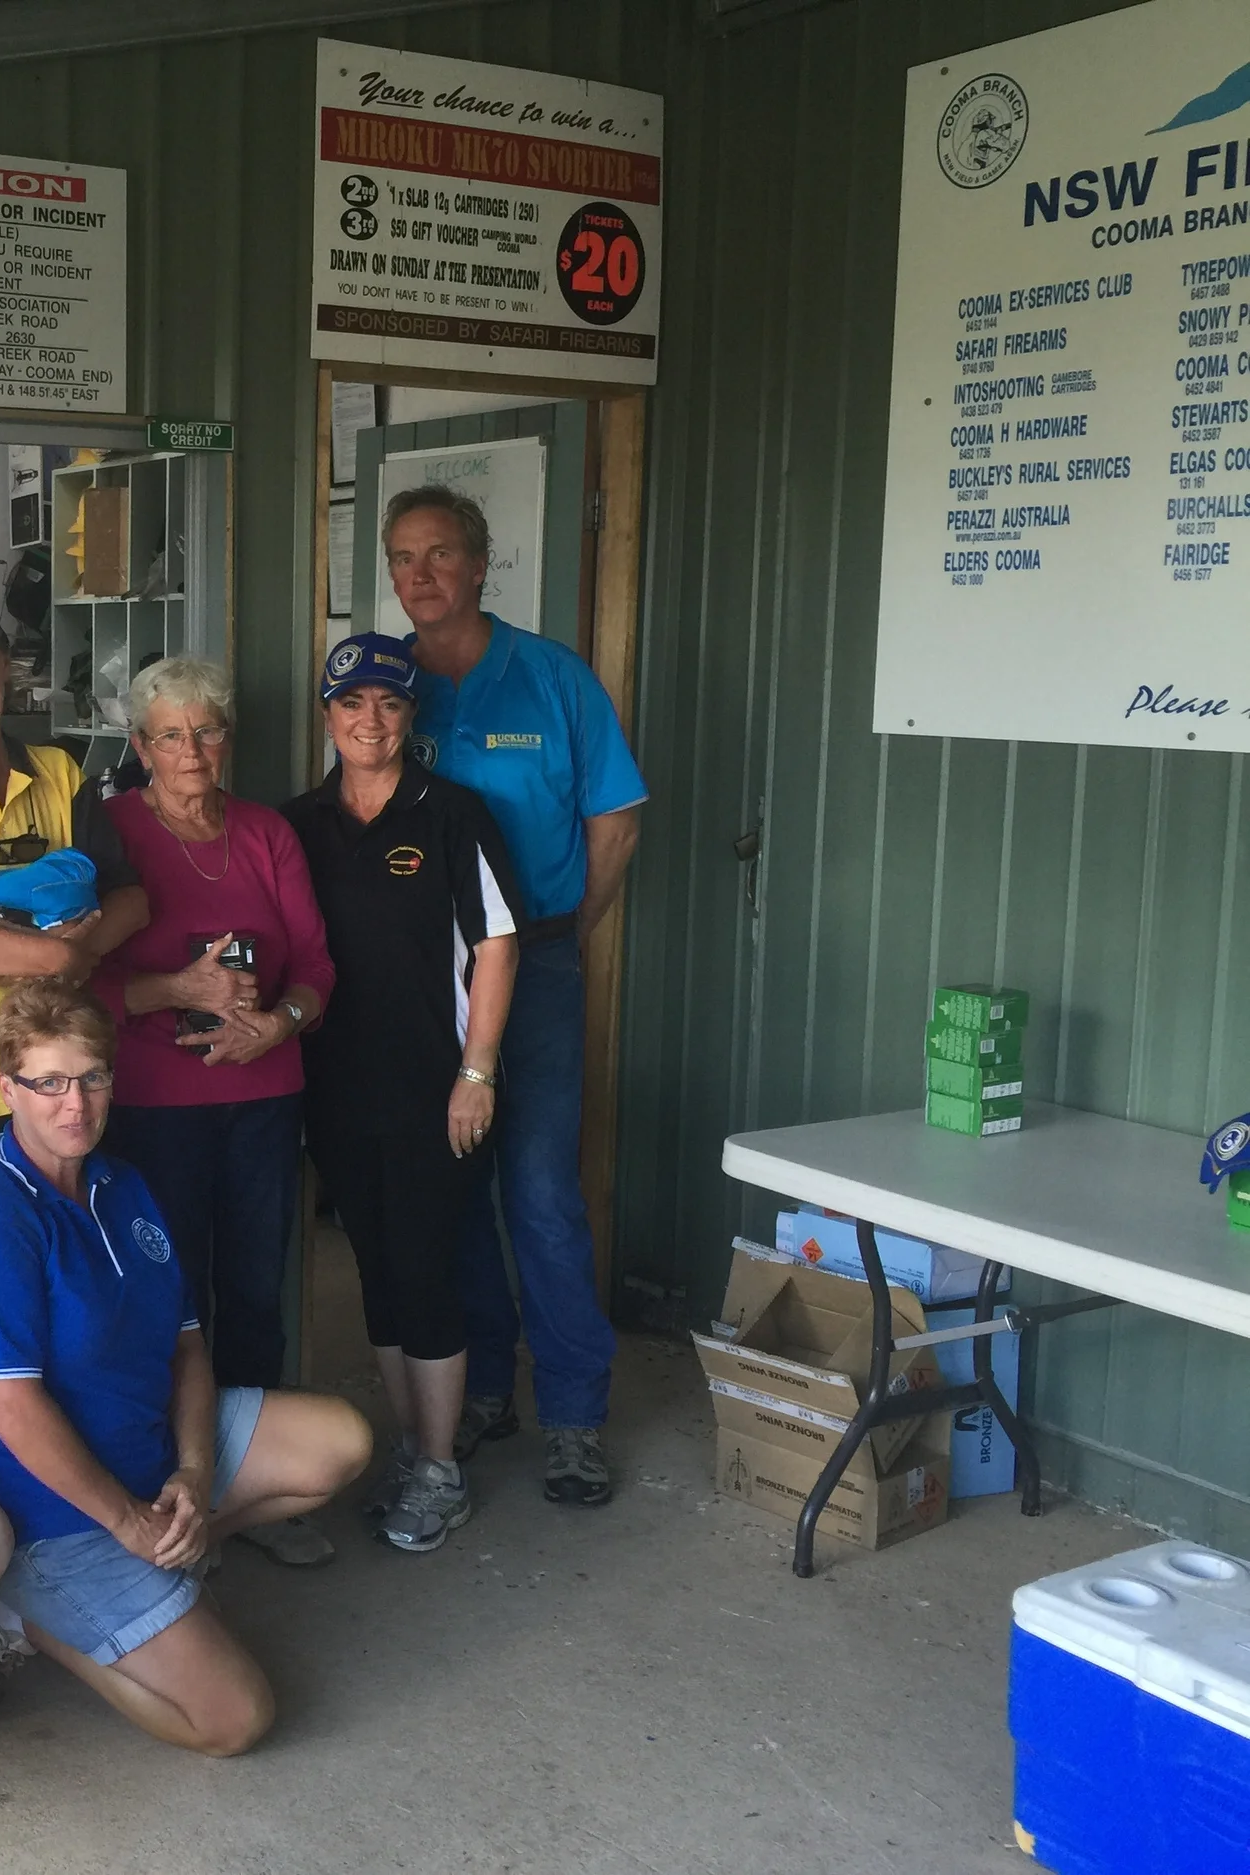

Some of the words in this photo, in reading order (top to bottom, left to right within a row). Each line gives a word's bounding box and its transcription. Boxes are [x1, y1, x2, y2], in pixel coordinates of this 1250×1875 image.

[359, 72, 425, 108] Your
[434, 86, 514, 117] chance
[519, 102, 544, 124] to
[551, 110, 592, 130] win
[942, 87, 978, 138] COOMA
[983, 80, 1024, 121] BRANCH
[336, 116, 443, 168] MIROKU
[452, 131, 520, 178] MK70
[527, 142, 632, 193] SPORTER
[1024, 157, 1158, 227] NSW
[1185, 138, 1250, 197] FI
[346, 177, 376, 202] 2nd
[406, 188, 428, 208] SLAB
[435, 192, 449, 212] 12g
[455, 194, 508, 218] CARTRIDGES
[1, 204, 23, 220] OR
[34, 207, 106, 228] INCIDENT
[584, 214, 624, 229] TICKETS
[1092, 215, 1173, 248] COOMA
[1184, 201, 1250, 233] BRAN
[346, 211, 375, 236] 3rd
[391, 218, 406, 238] $50
[412, 221, 432, 240] GIFT
[437, 223, 479, 247] VOUCHER
[482, 230, 511, 242] CAMPING
[515, 234, 536, 244] WORLD
[15, 244, 72, 262] REQUIRE
[497, 242, 520, 254] COOMA
[4, 261, 22, 274] OR
[31, 264, 92, 280] INCIDENT
[330, 250, 367, 272] DRAWN
[372, 254, 386, 275] ON
[391, 256, 430, 279] SUNDAY
[434, 260, 446, 281] AT
[449, 262, 467, 283] THE
[471, 264, 540, 290] PRESENTATION
[559, 231, 639, 297] $20
[338, 283, 357, 295] YOU
[363, 286, 390, 298] DON'T
[396, 290, 417, 301] HAVE
[424, 292, 435, 303] TO
[440, 294, 450, 305] BE
[456, 296, 490, 308] PRESENT
[495, 300, 506, 310] TO
[587, 300, 614, 312] EACH
[959, 294, 1002, 319] COOMA
[1010, 280, 1089, 312] EX-SERVICES
[1098, 274, 1132, 298] CLUB
[22, 315, 58, 329] ROAD
[335, 310, 448, 336] SPONSORED
[459, 322, 480, 338] BY
[490, 325, 548, 345] SAFARI
[560, 332, 640, 353] FIREARMS
[1179, 306, 1231, 334] SNOWY
[6, 331, 35, 344] 2630
[956, 337, 997, 361] SAFARI
[1004, 328, 1066, 355] FIREARMS
[39, 350, 75, 363] ROAD
[1176, 354, 1228, 381] COOMA
[26, 366, 74, 380] COOMA
[83, 370, 112, 384] END)
[8, 384, 14, 395] &
[72, 388, 99, 400] EAST
[954, 375, 1044, 404] INTOSHOOTING
[1051, 381, 1096, 394] CARTRIDGES
[1172, 400, 1248, 428] STEWARTS
[162, 423, 201, 434] SORRY
[206, 426, 221, 436] NO
[170, 434, 212, 446] CREDIT
[951, 424, 994, 447] COOMA
[1001, 422, 1009, 442] H
[1016, 415, 1087, 441] HARDWARE
[424, 456, 492, 482] WELCOME
[949, 464, 1012, 488] BUCKLEY'S
[1019, 462, 1060, 483] RURAL
[1067, 456, 1130, 481] SERVICES
[1170, 450, 1216, 474] ELGAS
[948, 509, 995, 530] PERAZZI
[1002, 505, 1070, 528] AUSTRALIA
[944, 551, 988, 571] ELDERS
[996, 550, 1040, 570] COOMA
[1164, 543, 1230, 565] FAIRIDGE
[1125, 684, 1230, 719] Please
[738, 1362, 767, 1376] WING
[769, 1370, 809, 1389] BRONZE
[755, 1412, 783, 1428] WING
[785, 1421, 825, 1442] BRONZE
[980, 1411, 993, 1464] BRONZE
[756, 1476, 785, 1493] BRONZE
[787, 1486, 808, 1500] WING
